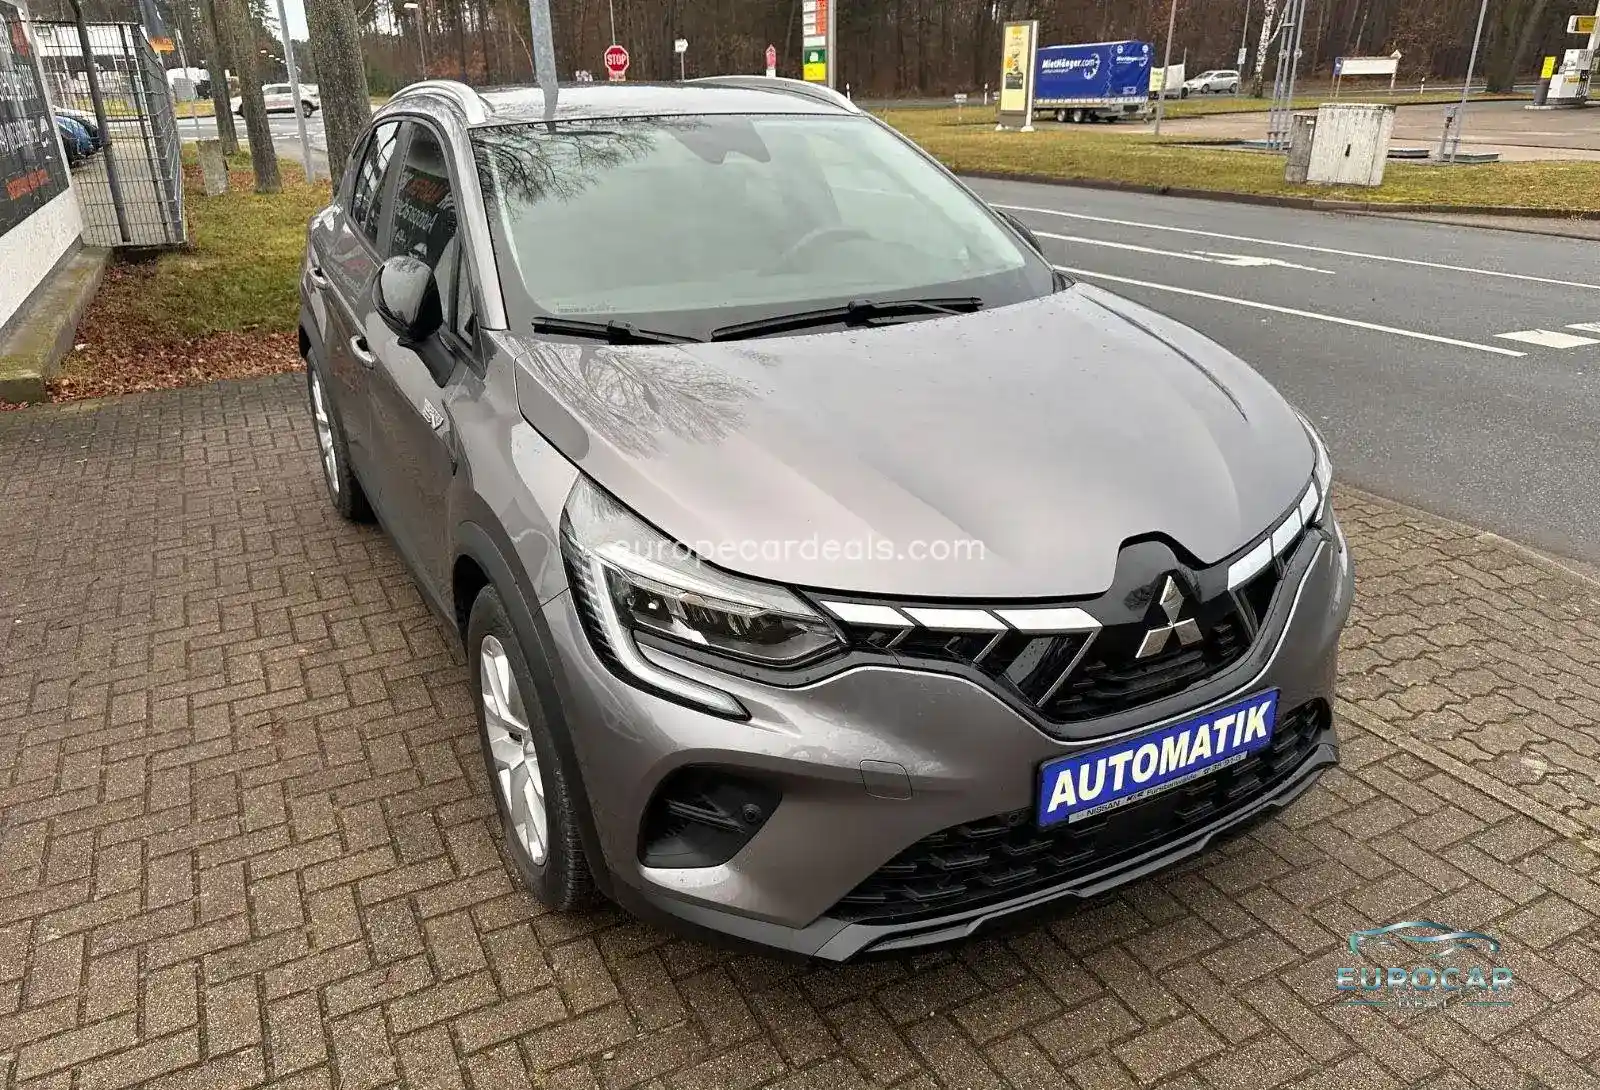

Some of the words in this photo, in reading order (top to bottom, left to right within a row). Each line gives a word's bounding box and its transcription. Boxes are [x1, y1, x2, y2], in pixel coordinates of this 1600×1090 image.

[607, 54, 627, 65] STOP
[1042, 57, 1095, 70] MietHänger.com
[1047, 700, 1272, 812] AUTOMATIK
[1086, 799, 1120, 817] NISSAN
